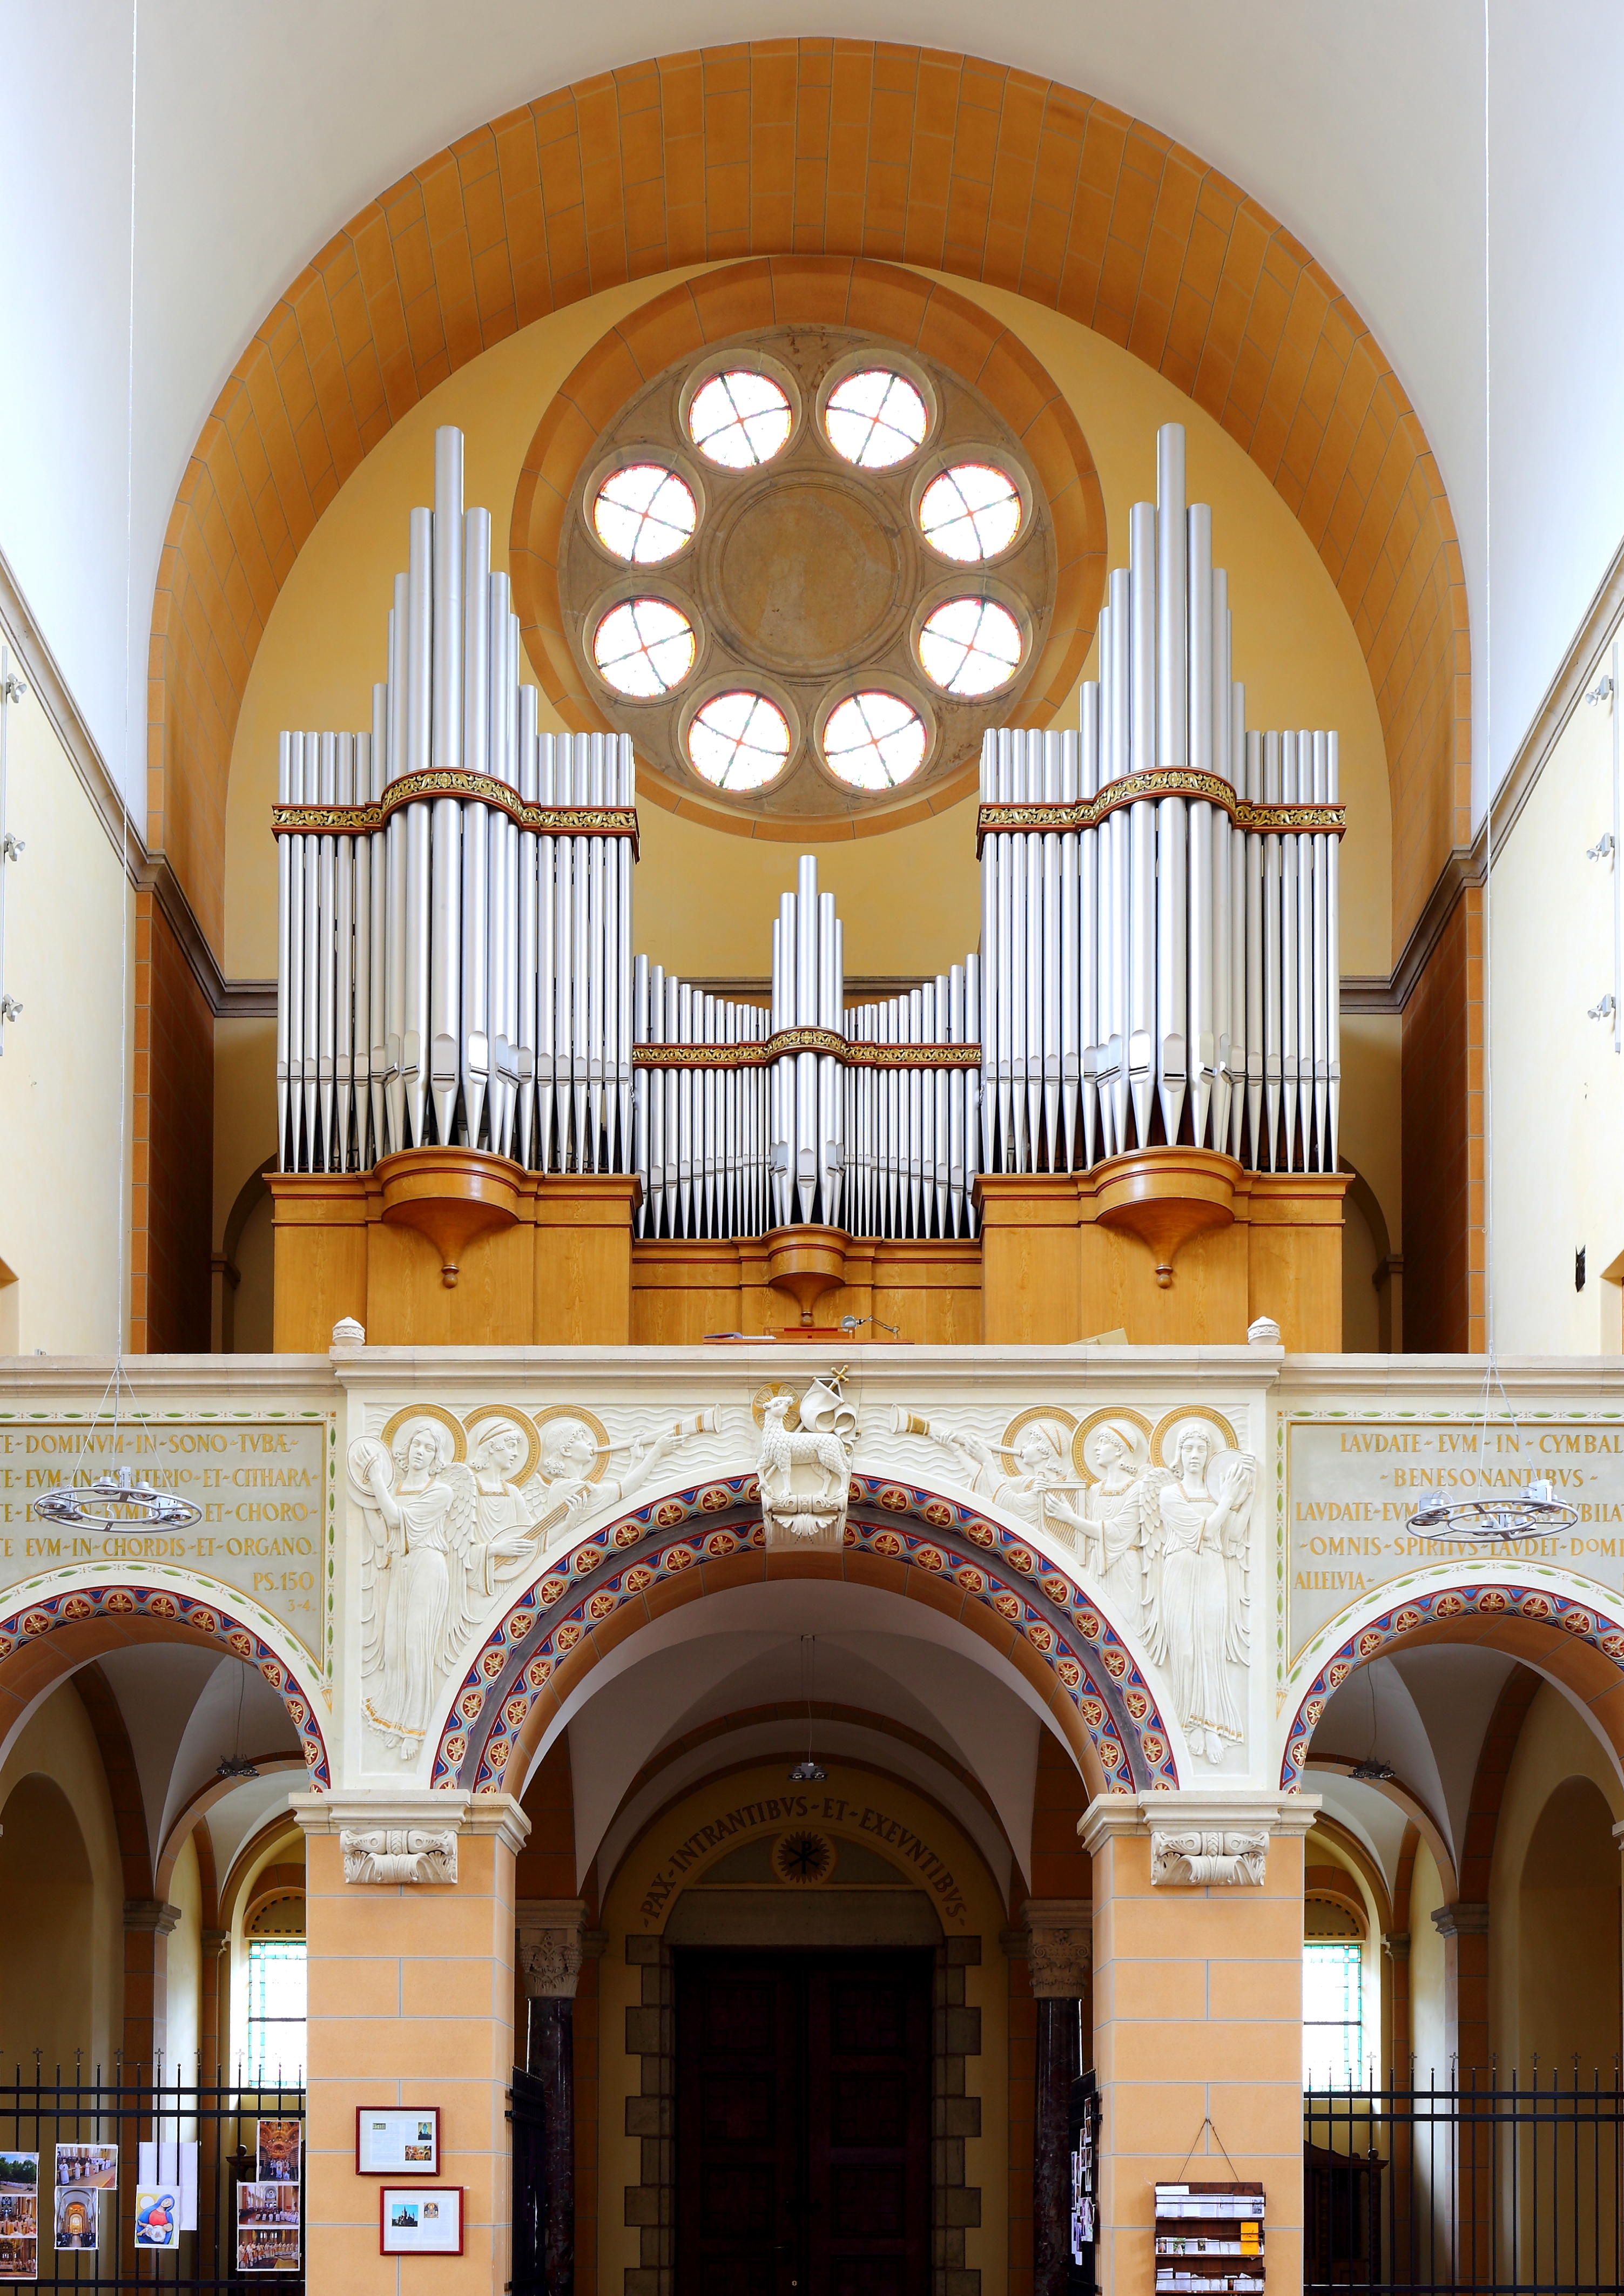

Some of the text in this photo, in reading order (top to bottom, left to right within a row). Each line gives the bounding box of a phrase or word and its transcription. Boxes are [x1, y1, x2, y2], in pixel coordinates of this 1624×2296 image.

[25, 1434, 124, 1454] DOMINVM
[136, 1435, 157, 1453] IN
[169, 1434, 227, 1453] SONO
[1340, 1434, 1624, 1453] LAVDATE EVM IN CYMBAL
[25, 1469, 60, 1488] EVM
[72, 1469, 92, 1488] IN
[203, 1468, 223, 1488] ET
[232, 1468, 312, 1487] CITHARA
[1393, 1468, 1584, 1488] BENESONANTIBVS
[25, 1503, 60, 1522] EV
[205, 1503, 225, 1522] ET
[235, 1502, 308, 1522] CHORO
[1296, 1502, 1372, 1521] LAVDATE
[1383, 1502, 1418, 1521] EVM
[25, 1537, 61, 1557] EVM
[72, 1538, 92, 1557] IN
[103, 1537, 186, 1557] CHORDIS
[197, 1537, 217, 1557] ET
[1309, 1537, 1382, 1556] OMNIS
[1393, 1537, 1478, 1556] SPIRITVS
[1490, 1537, 1560, 1556] LAVDET
[1293, 1571, 1366, 1590] ALLELVIA
[640, 1796, 967, 1919] PAX INTRANTIBVS ET EXEVNTIBVS
